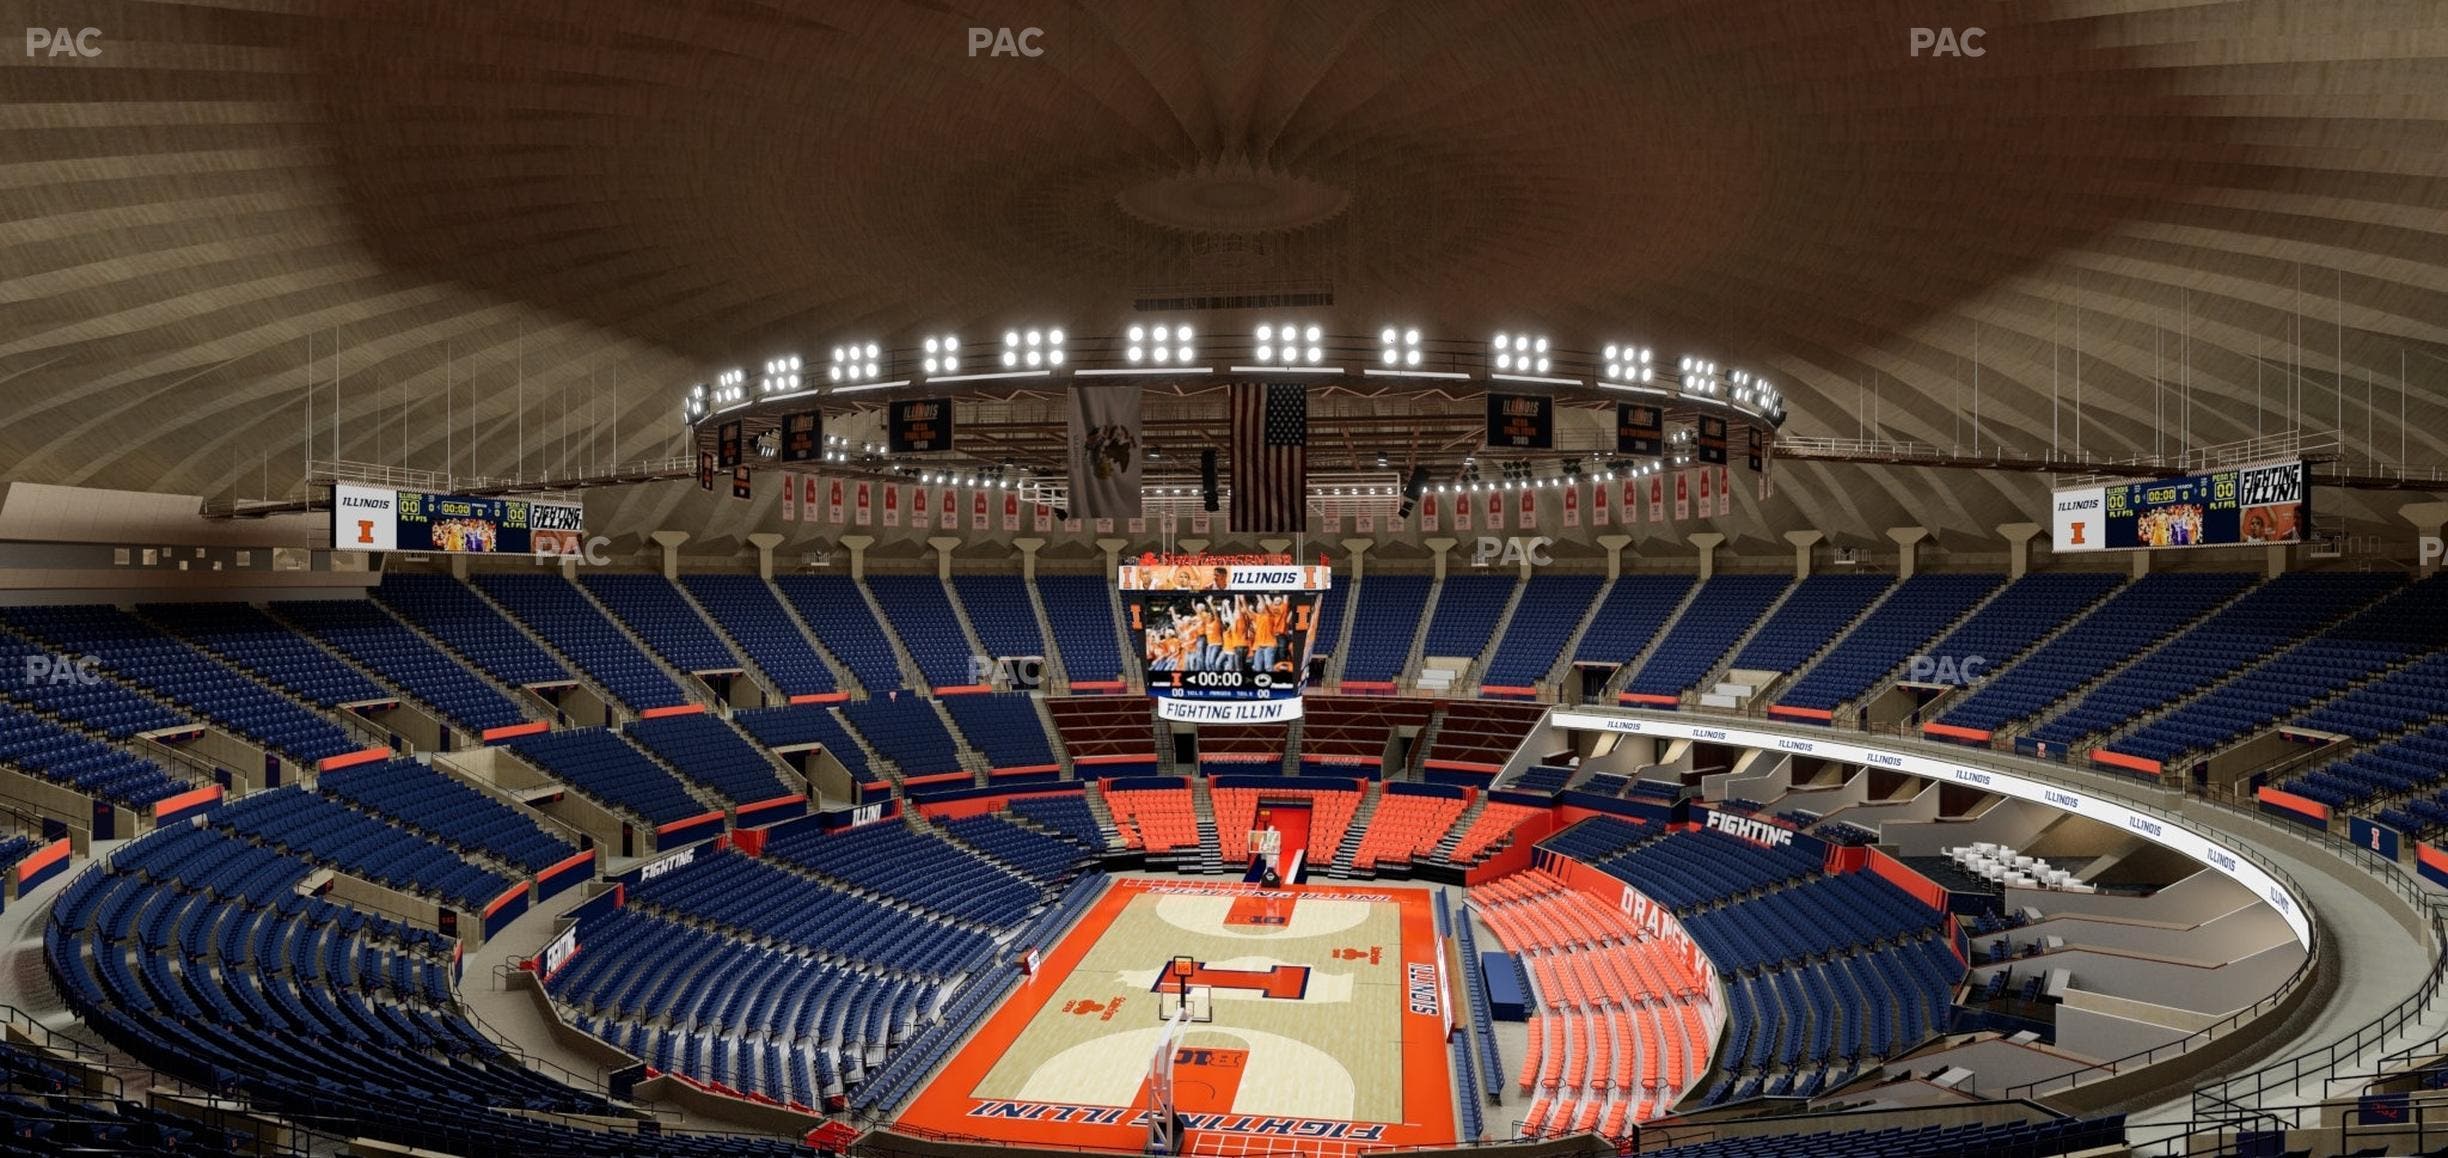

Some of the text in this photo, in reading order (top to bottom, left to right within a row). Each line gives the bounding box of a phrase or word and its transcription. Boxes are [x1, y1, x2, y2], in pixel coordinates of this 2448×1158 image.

[2243, 464, 2301, 486] FIGHTING
[343, 497, 390, 509] ILLINOIS
[2058, 499, 2099, 511] ILLINOIS
[533, 505, 581, 518] FIGHTING
[1232, 572, 1297, 584] ILLINOIS
[1198, 672, 1242, 686] 00:00
[1172, 688, 1184, 698] 00
[1257, 689, 1270, 698] 00
[1167, 703, 1282, 719] FIGHTING ILLINI
[1607, 721, 1640, 730] ILLINOIS
[1693, 729, 1726, 740] ILLINOIS
[1778, 739, 1812, 751] ILLINOIS
[1867, 752, 1902, 767] ILLINOIS
[1956, 769, 1991, 785] ILLINOIS
[2045, 790, 2078, 808] ILLINOIS
[1706, 810, 1793, 847] FIGHTING
[2129, 816, 2161, 836] ILLINOIS
[2207, 848, 2236, 872] ILLINOIS
[967, 1100, 1126, 1126] ILLINI
